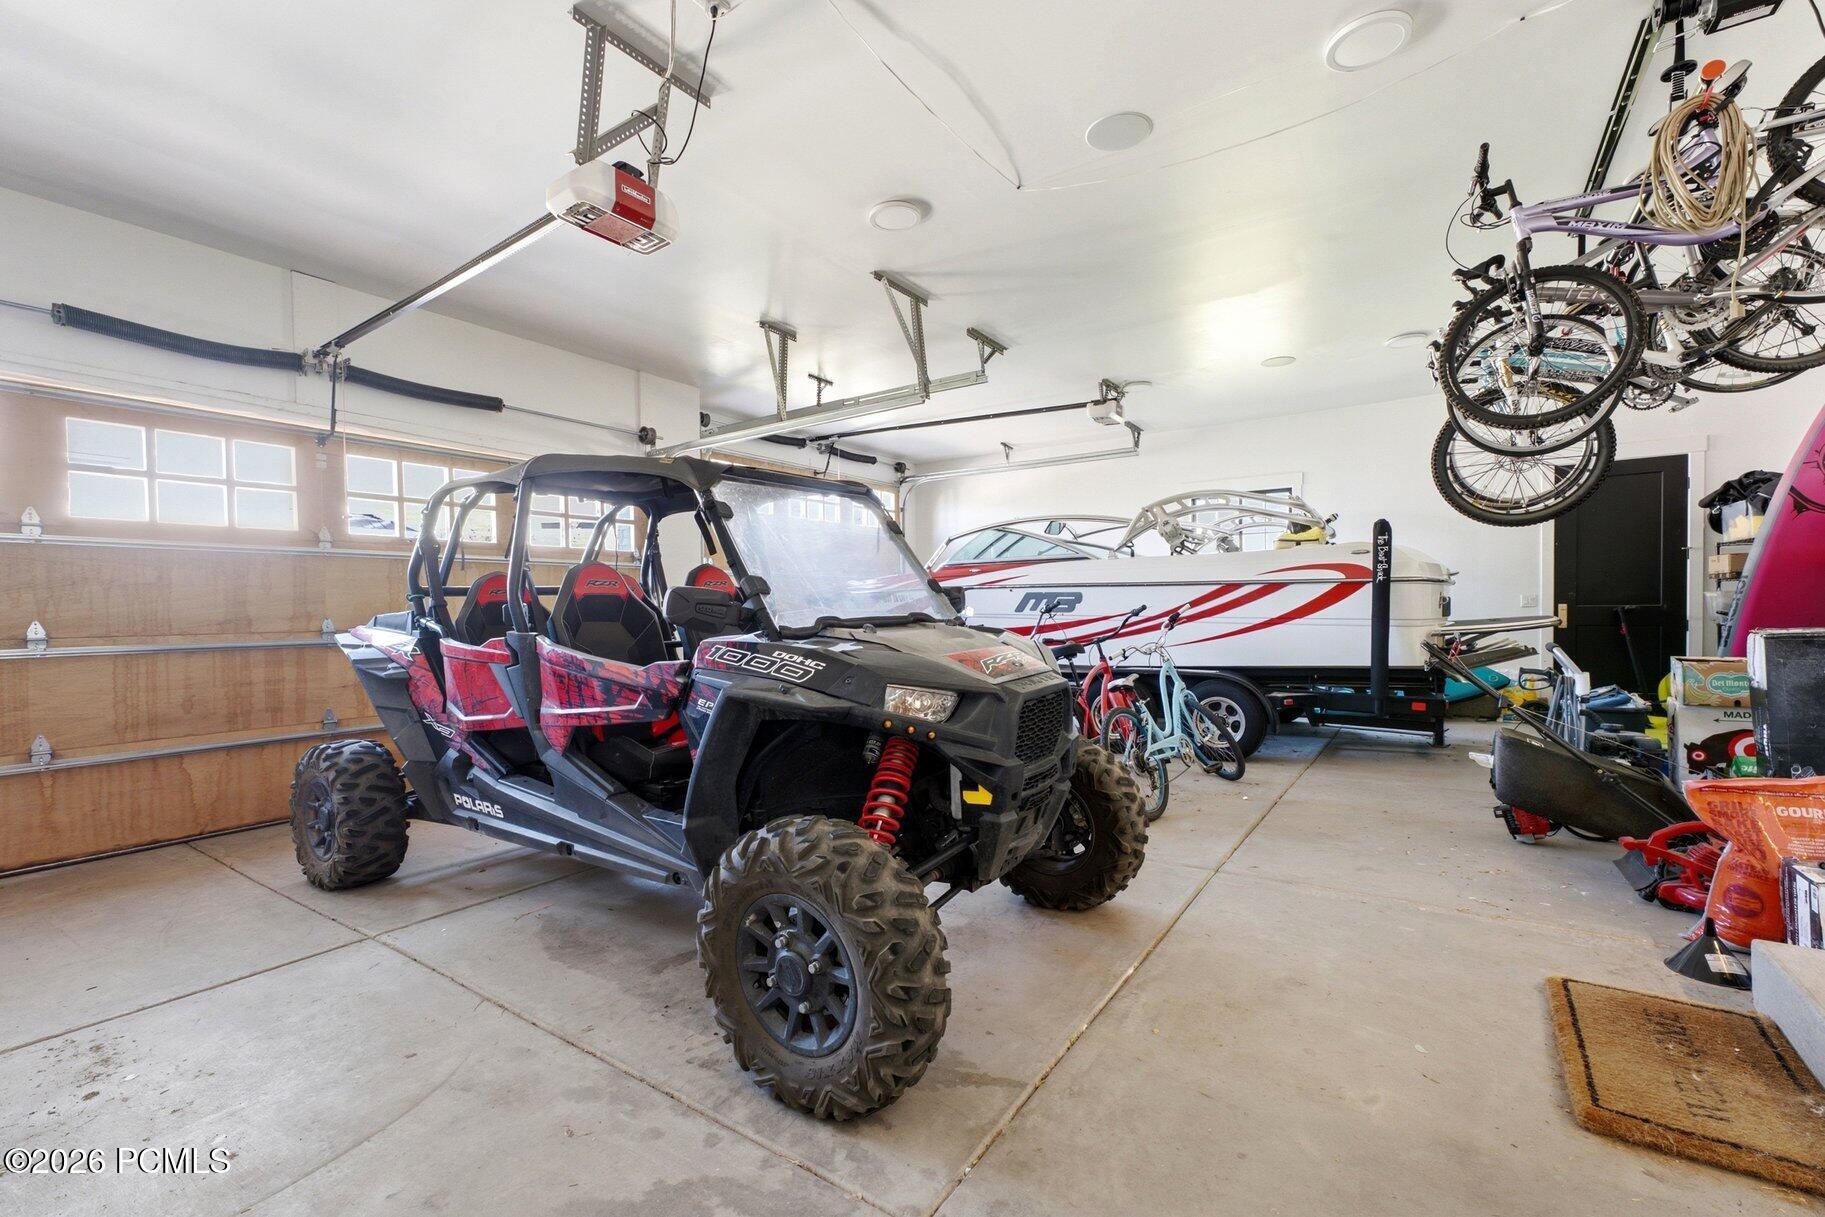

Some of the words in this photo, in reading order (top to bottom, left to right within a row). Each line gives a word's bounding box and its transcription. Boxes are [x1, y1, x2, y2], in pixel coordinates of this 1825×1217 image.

[586, 579, 620, 588] RZR
[703, 580, 728, 588] RZR
[705, 644, 815, 683] 1000
[771, 650, 827, 670] DOHC
[1723, 711, 1752, 719] MAD
[453, 793, 504, 819] POLARIS
[1776, 806, 1825, 820] GOUR
